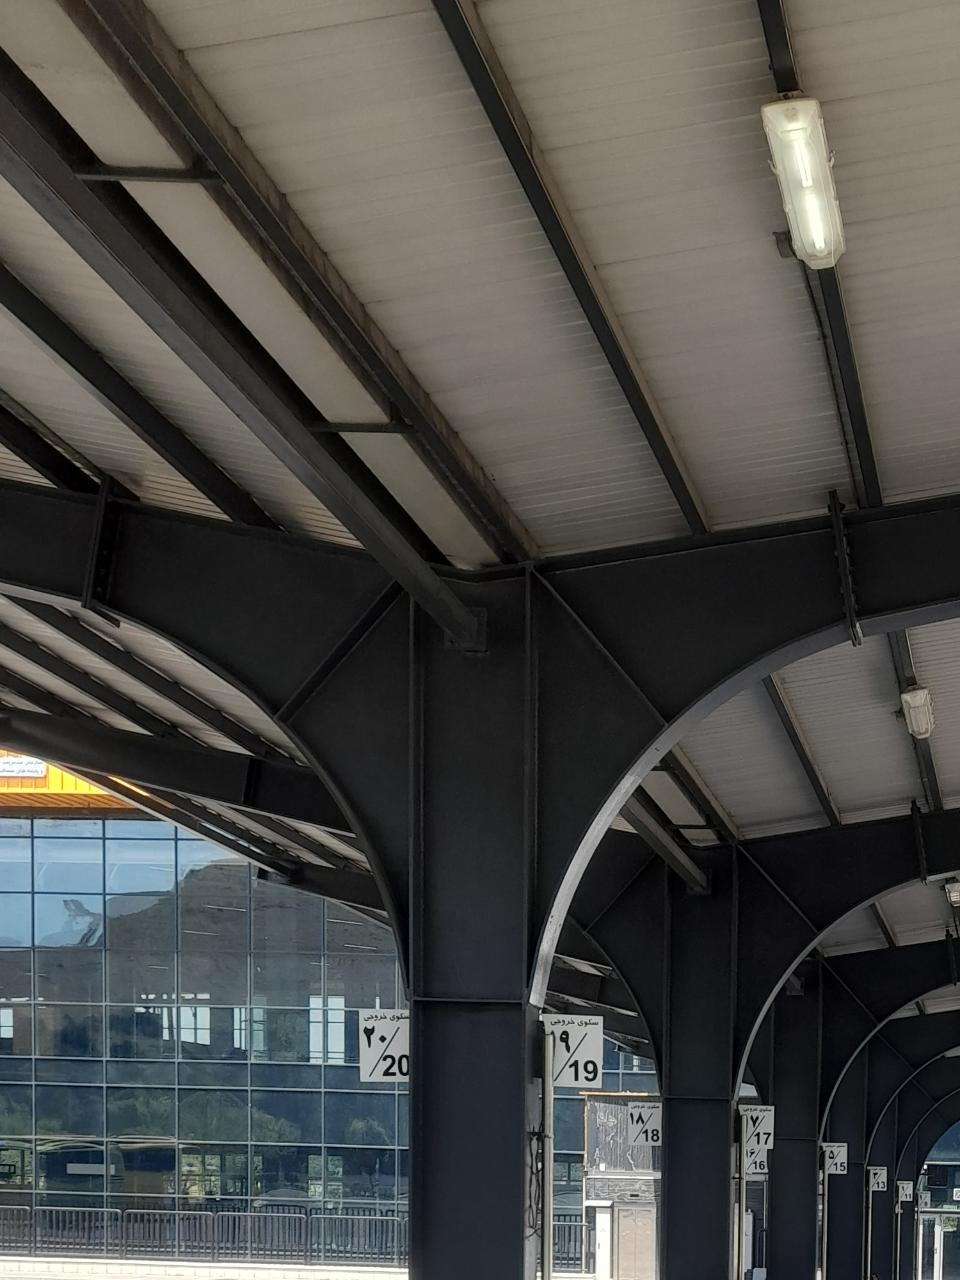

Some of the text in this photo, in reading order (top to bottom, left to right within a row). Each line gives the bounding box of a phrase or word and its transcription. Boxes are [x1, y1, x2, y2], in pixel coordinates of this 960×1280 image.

[551, 1017, 575, 1026] خروجی
[363, 1025, 387, 1048] ۲۰
[382, 1054, 409, 1077] 20
[569, 1059, 599, 1082] 19
[630, 1111, 645, 1125] ۱۸
[642, 1129, 660, 1142] 18
[754, 1132, 772, 1145] 17
[753, 1160, 766, 1171] 16
[833, 1162, 846, 1171] 15
[876, 1181, 886, 1189] 13
